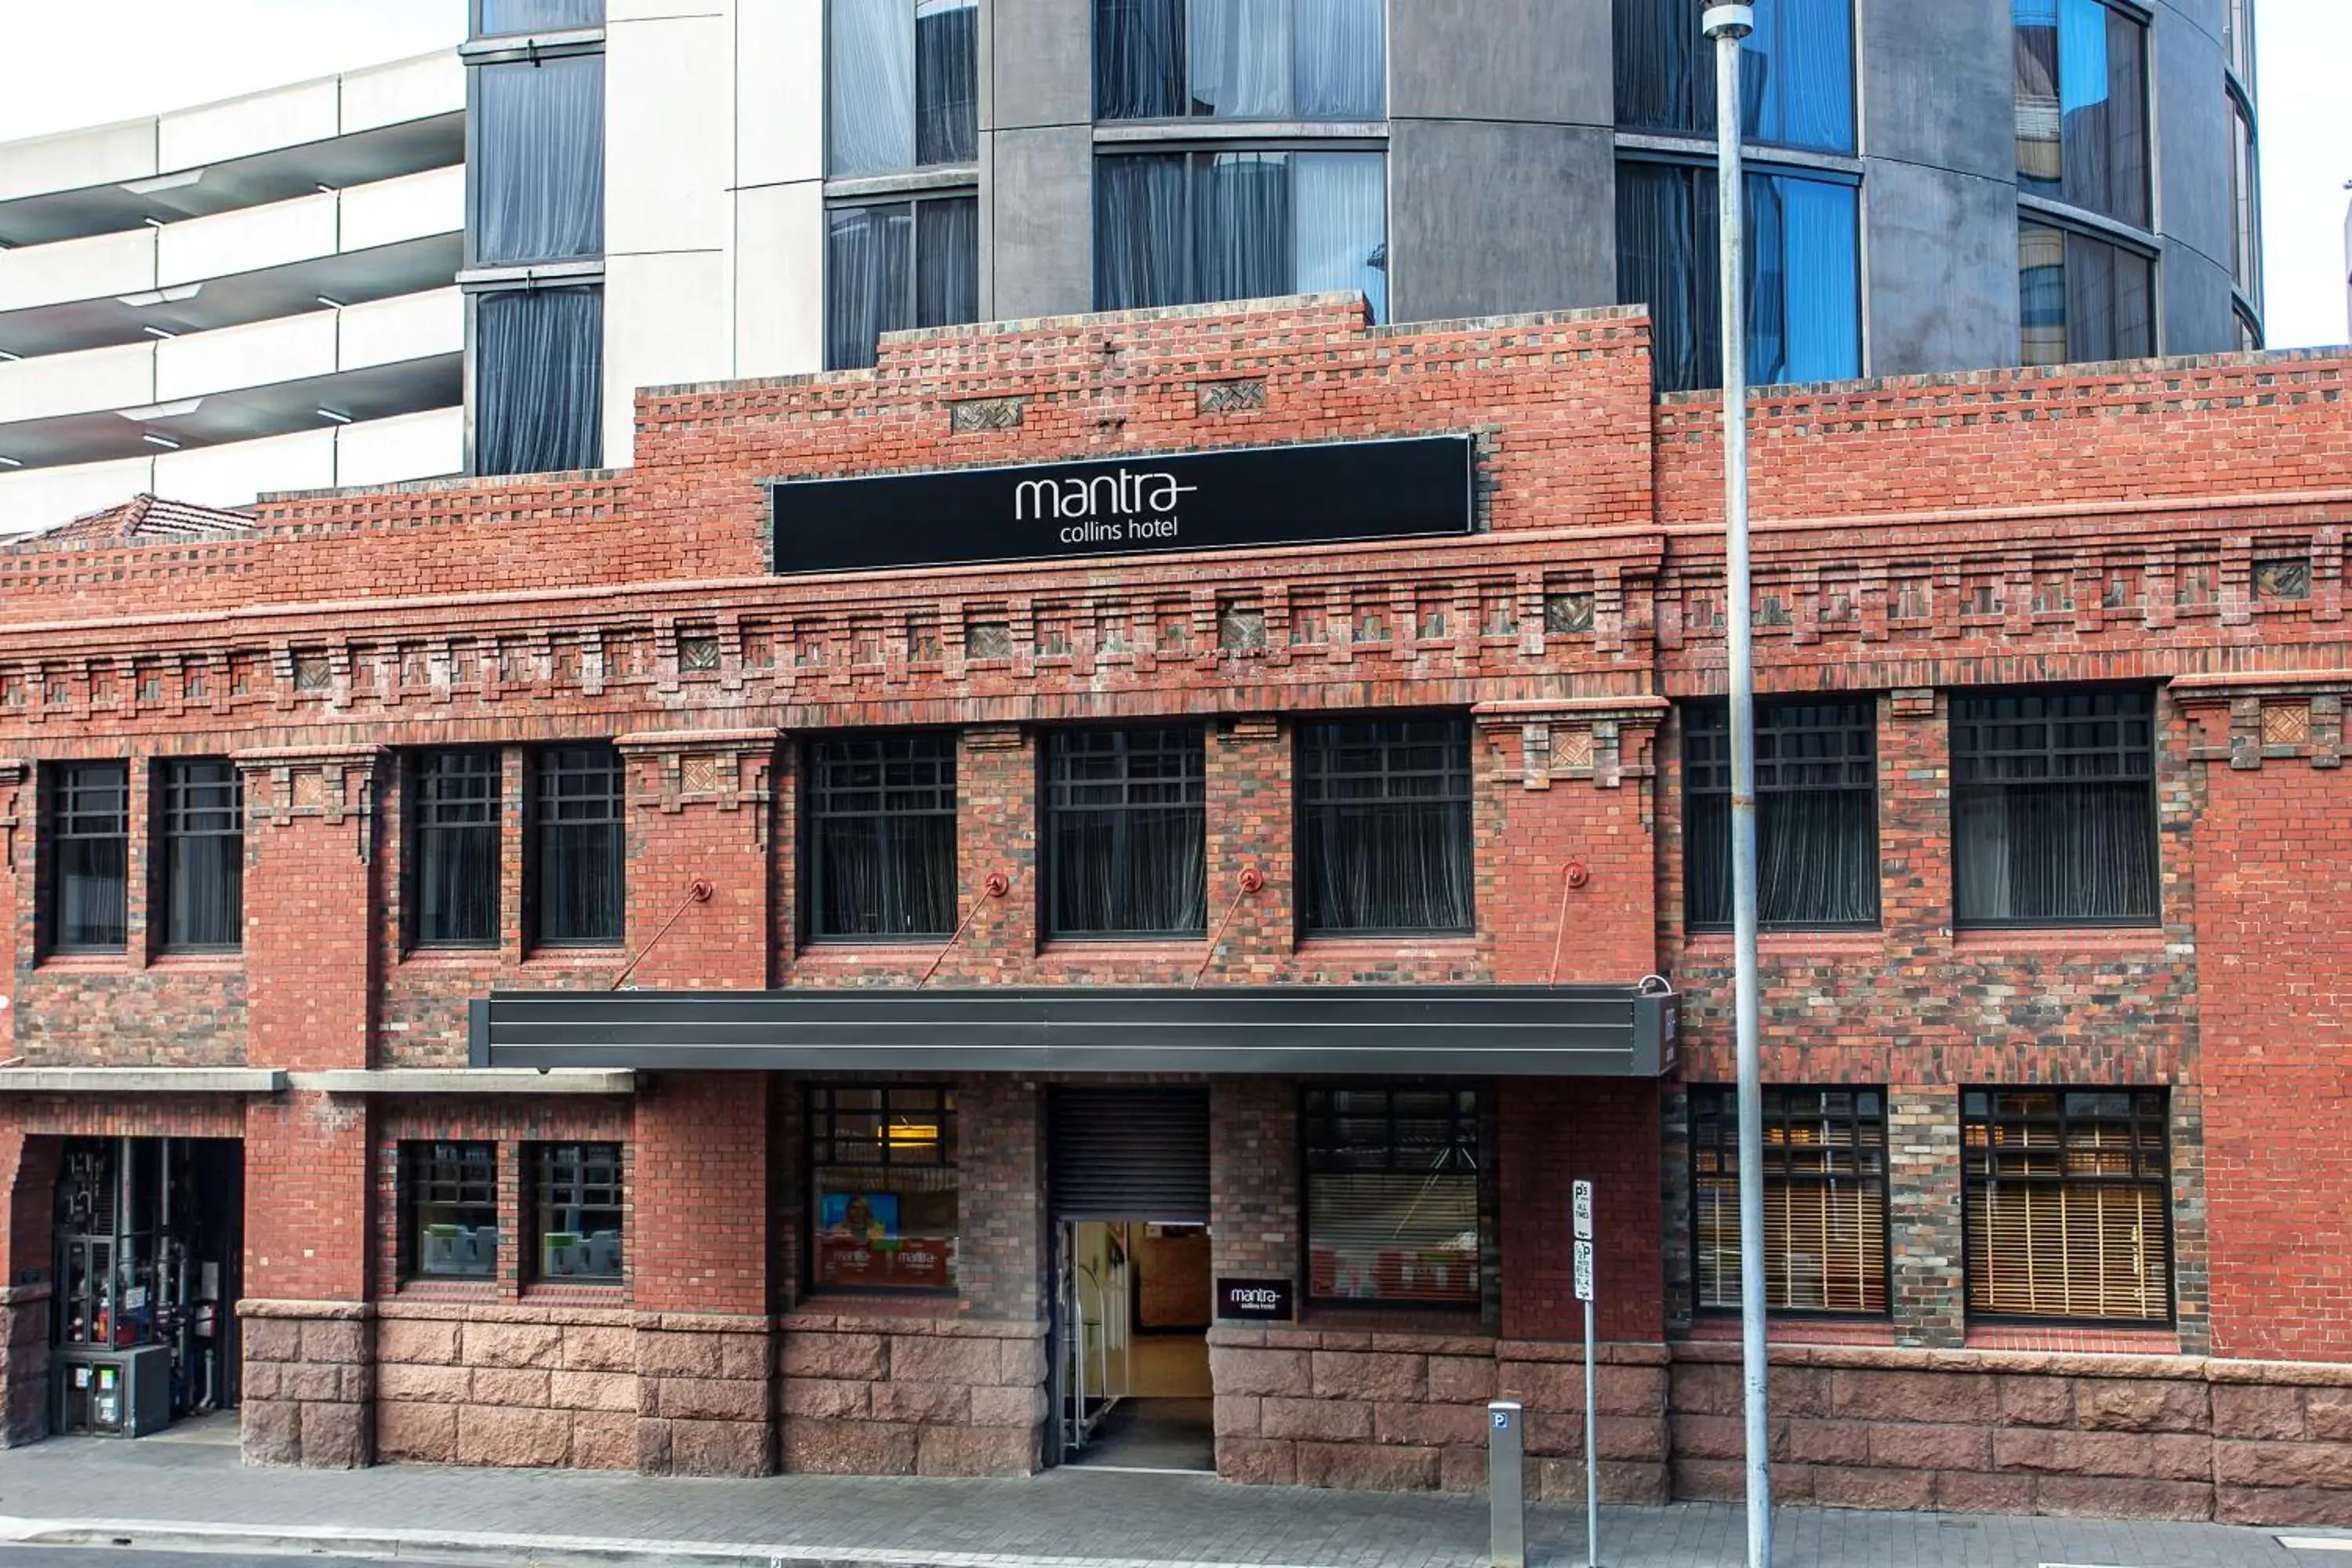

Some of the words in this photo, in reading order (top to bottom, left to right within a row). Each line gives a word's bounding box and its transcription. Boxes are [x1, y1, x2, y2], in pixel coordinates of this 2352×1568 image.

[1015, 468, 1197, 520] mantra
[1060, 521, 1122, 543] collins
[1128, 516, 1177, 539] hotel
[1231, 1288, 1282, 1302] mantra
